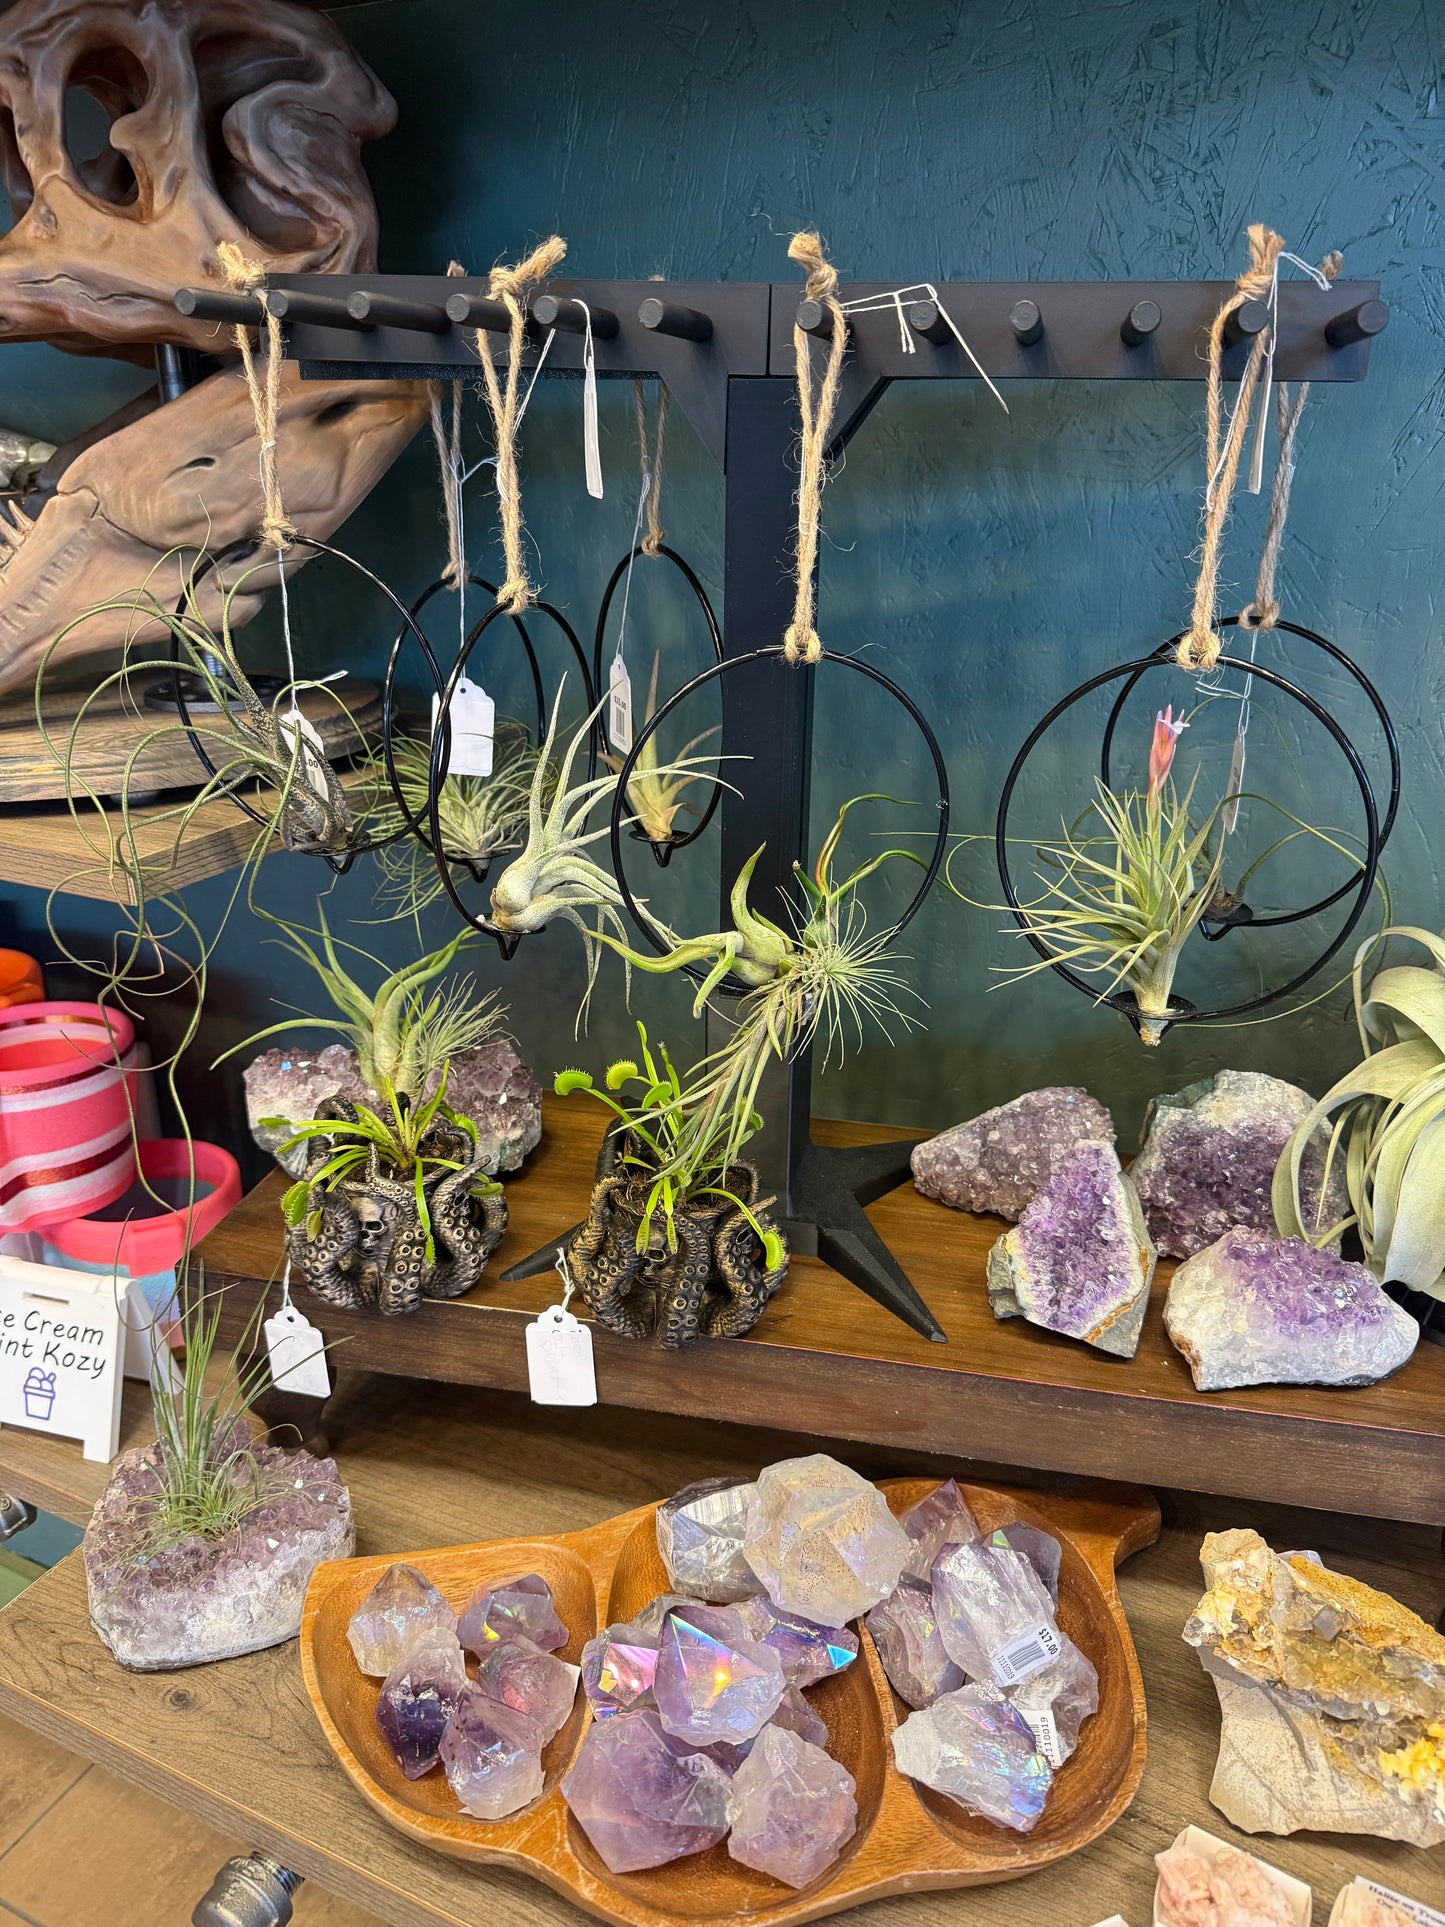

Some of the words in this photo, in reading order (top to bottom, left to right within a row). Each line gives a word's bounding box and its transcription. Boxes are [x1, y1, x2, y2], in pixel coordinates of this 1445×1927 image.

[24, 1310, 104, 1345] Cream
[43, 1341, 106, 1379] Kozy
[1038, 1628, 1058, 1655] $17.00
